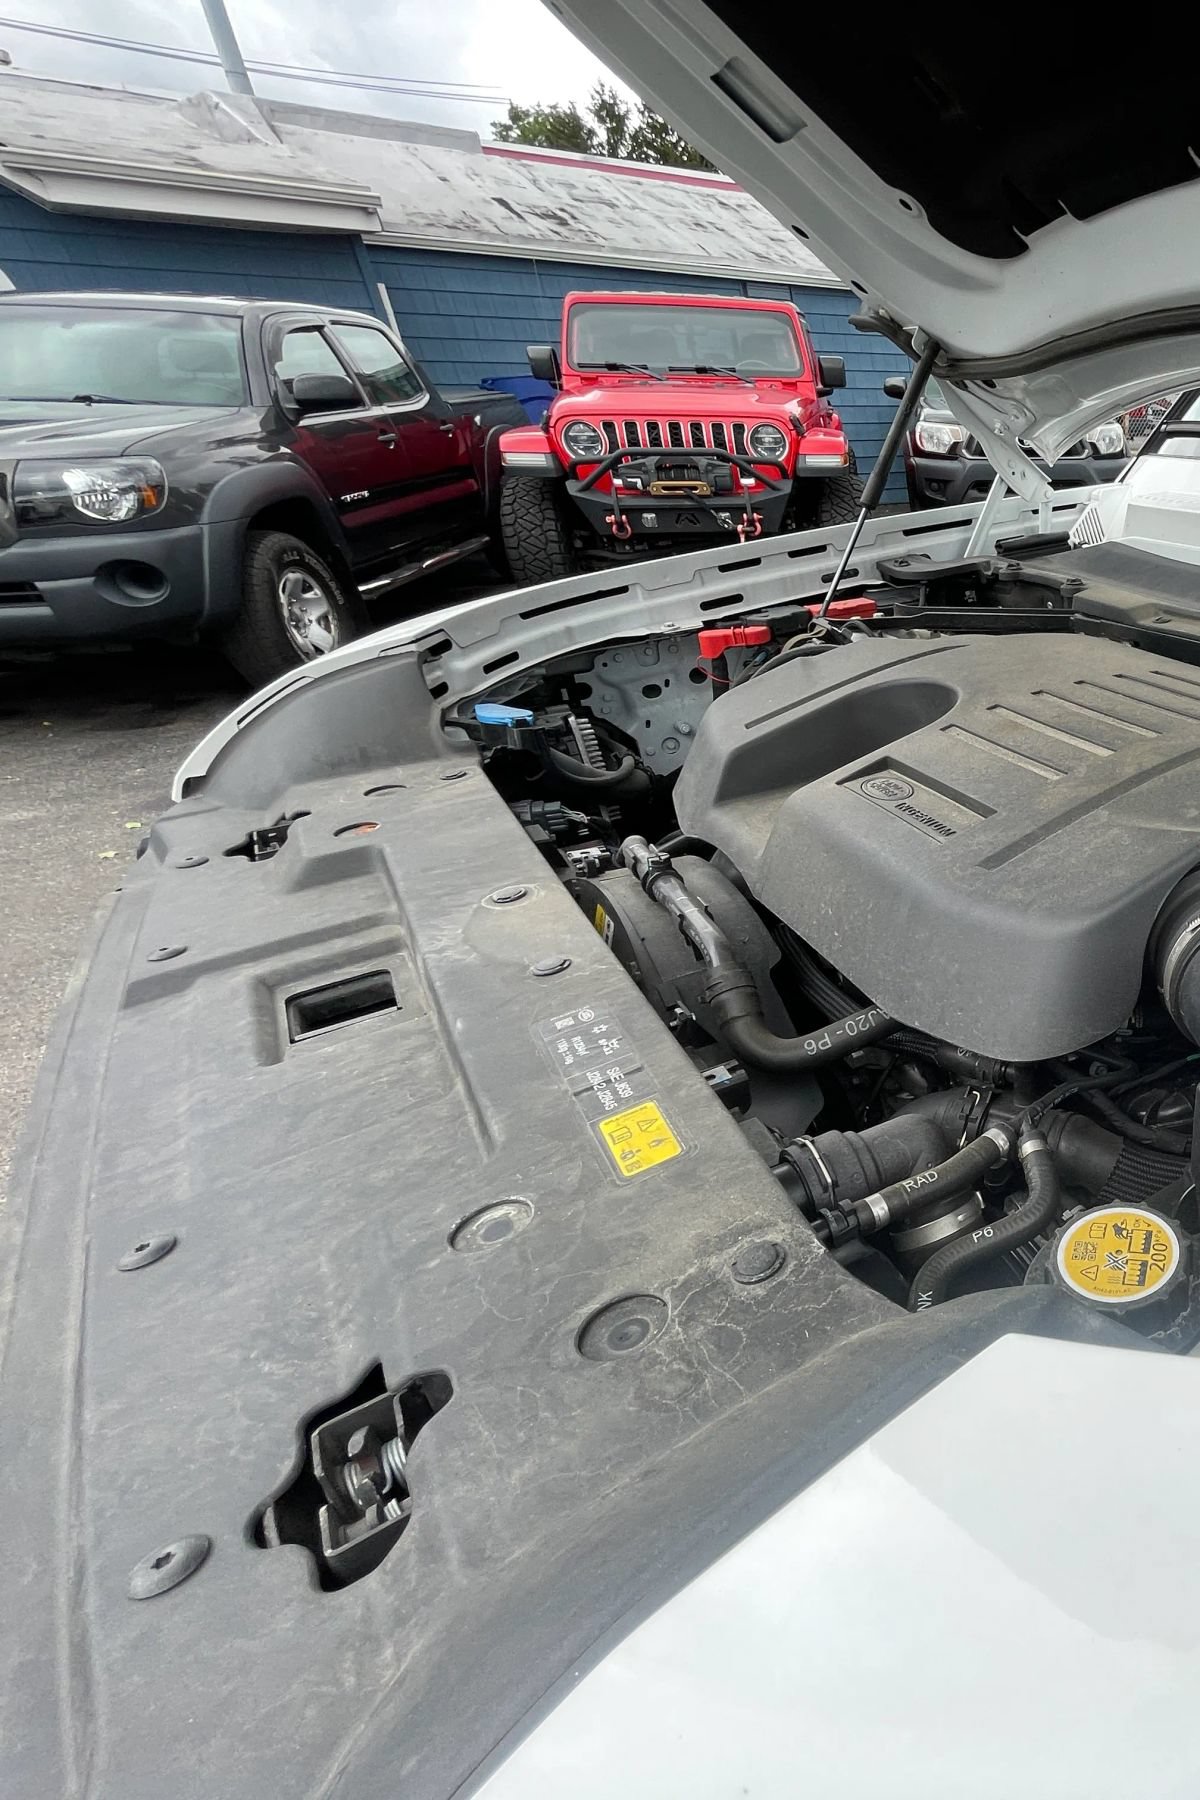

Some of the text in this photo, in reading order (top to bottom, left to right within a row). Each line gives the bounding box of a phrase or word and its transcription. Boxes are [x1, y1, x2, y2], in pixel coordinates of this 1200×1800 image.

[895, 802, 957, 837] INGENIUM
[902, 1170, 939, 1193] RAD
[971, 1226, 994, 1244] P6
[1149, 1243, 1168, 1273] 200
